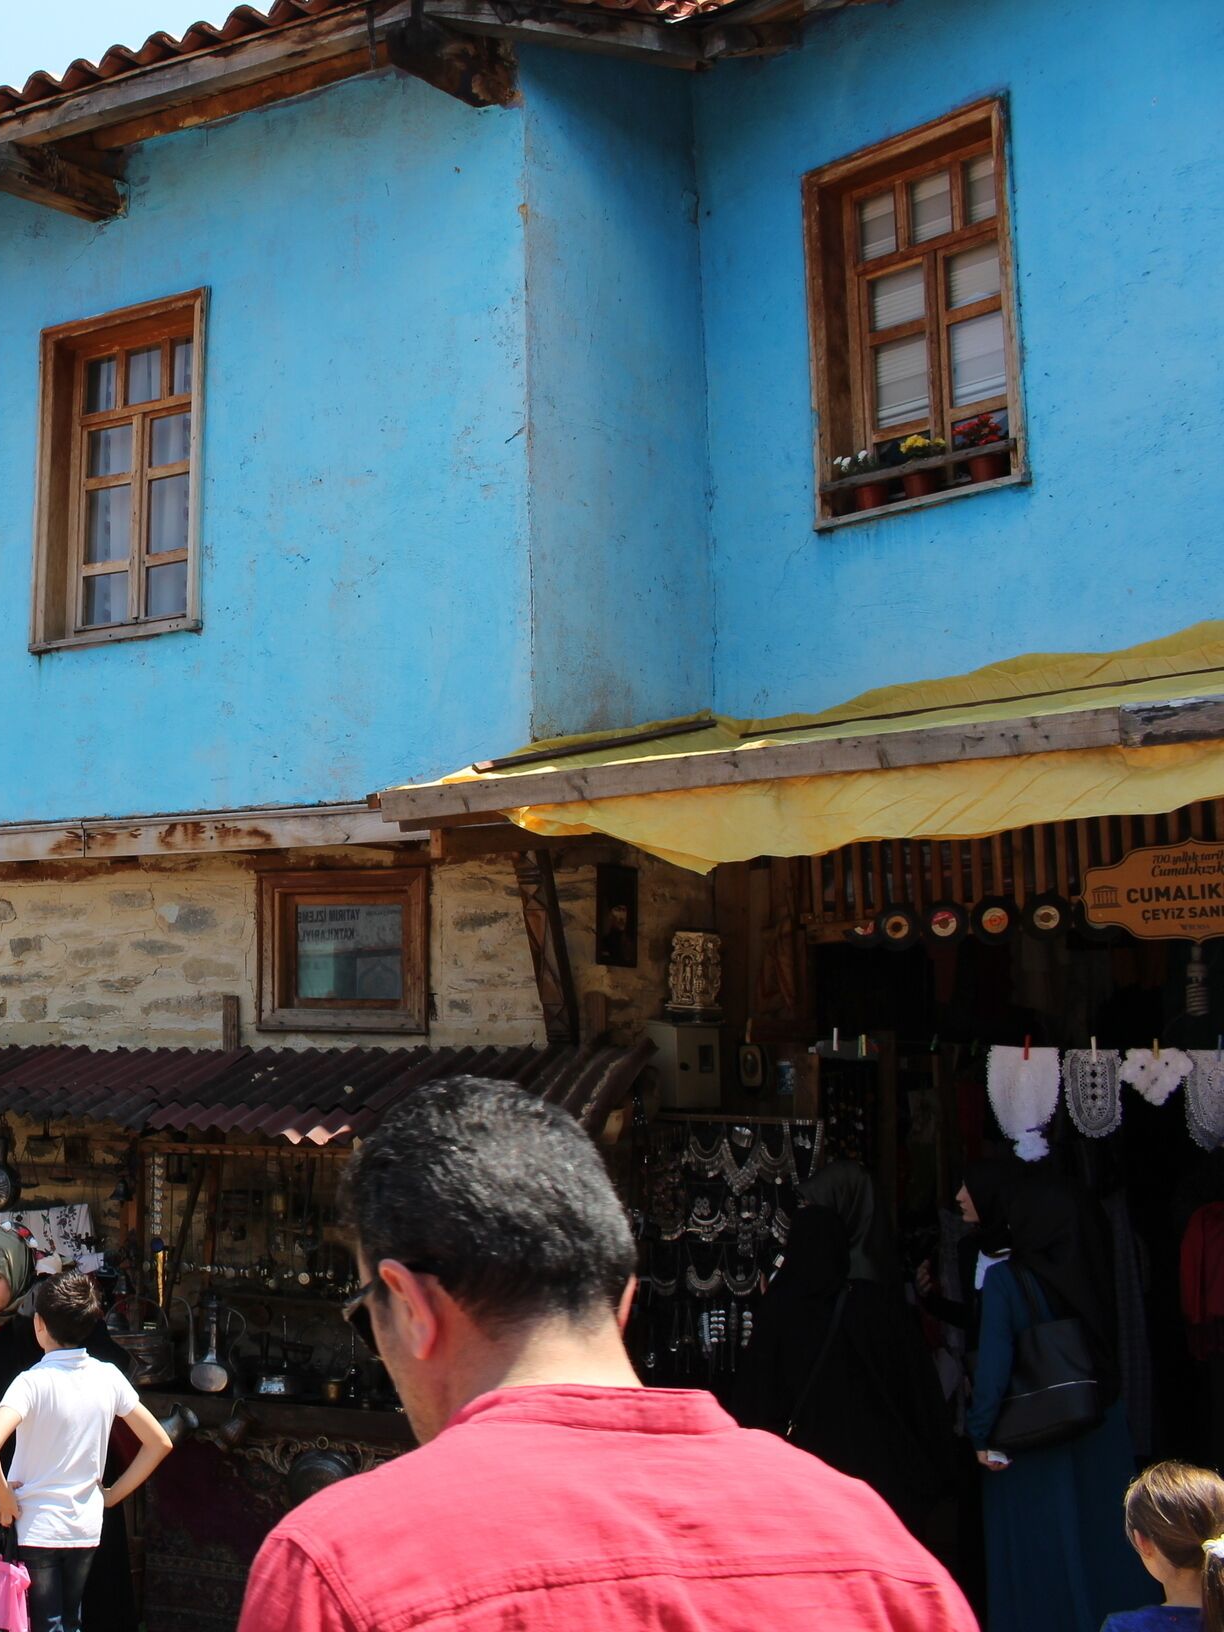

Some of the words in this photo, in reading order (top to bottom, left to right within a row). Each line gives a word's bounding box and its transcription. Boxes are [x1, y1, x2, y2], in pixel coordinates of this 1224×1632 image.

[1152, 854, 1170, 865] 700
[1127, 883, 1224, 903] CUMALIK
[1188, 904, 1224, 919] SAN
